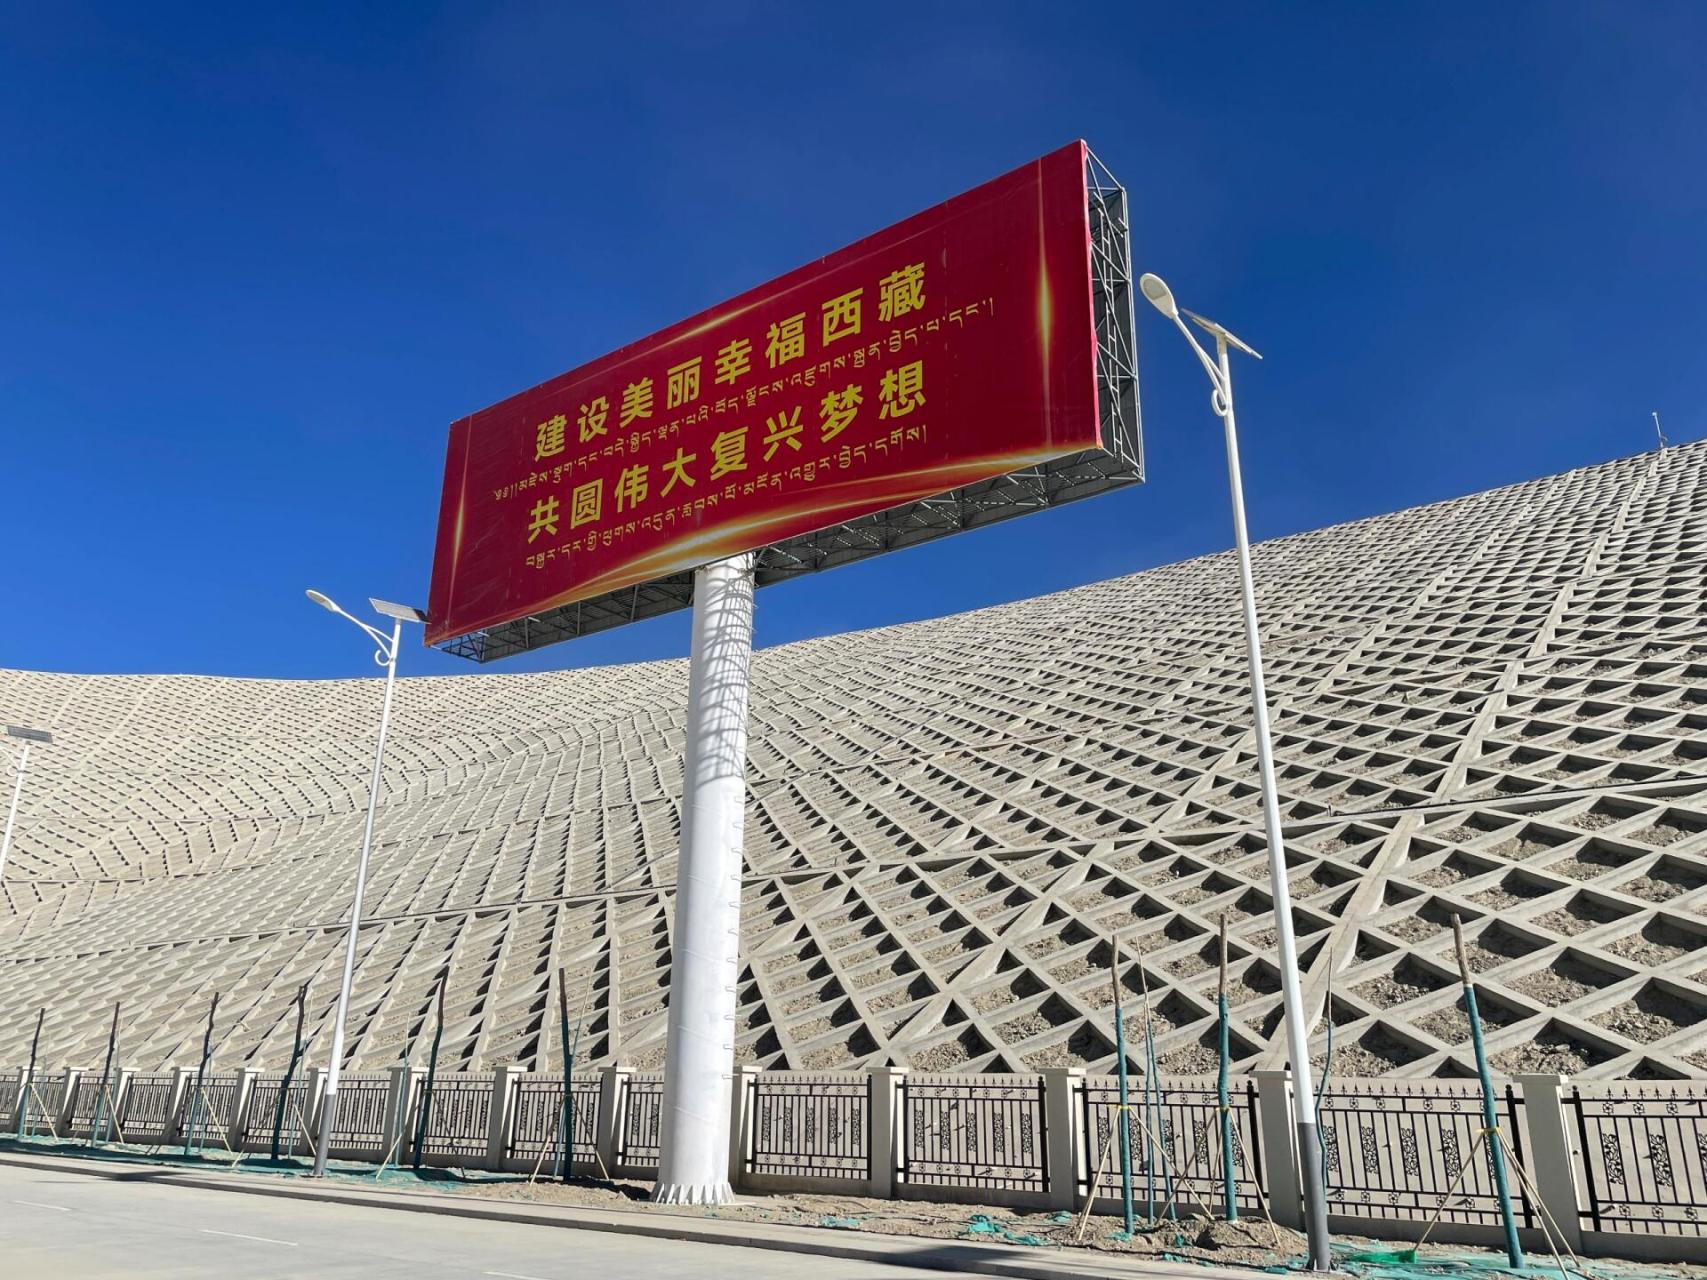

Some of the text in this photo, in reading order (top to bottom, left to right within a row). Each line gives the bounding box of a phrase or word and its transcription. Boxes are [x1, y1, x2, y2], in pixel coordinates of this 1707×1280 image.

[526, 359, 926, 545] 共圆伟大复兴梦想
[533, 261, 926, 462] 建设美丽幸福西藏
